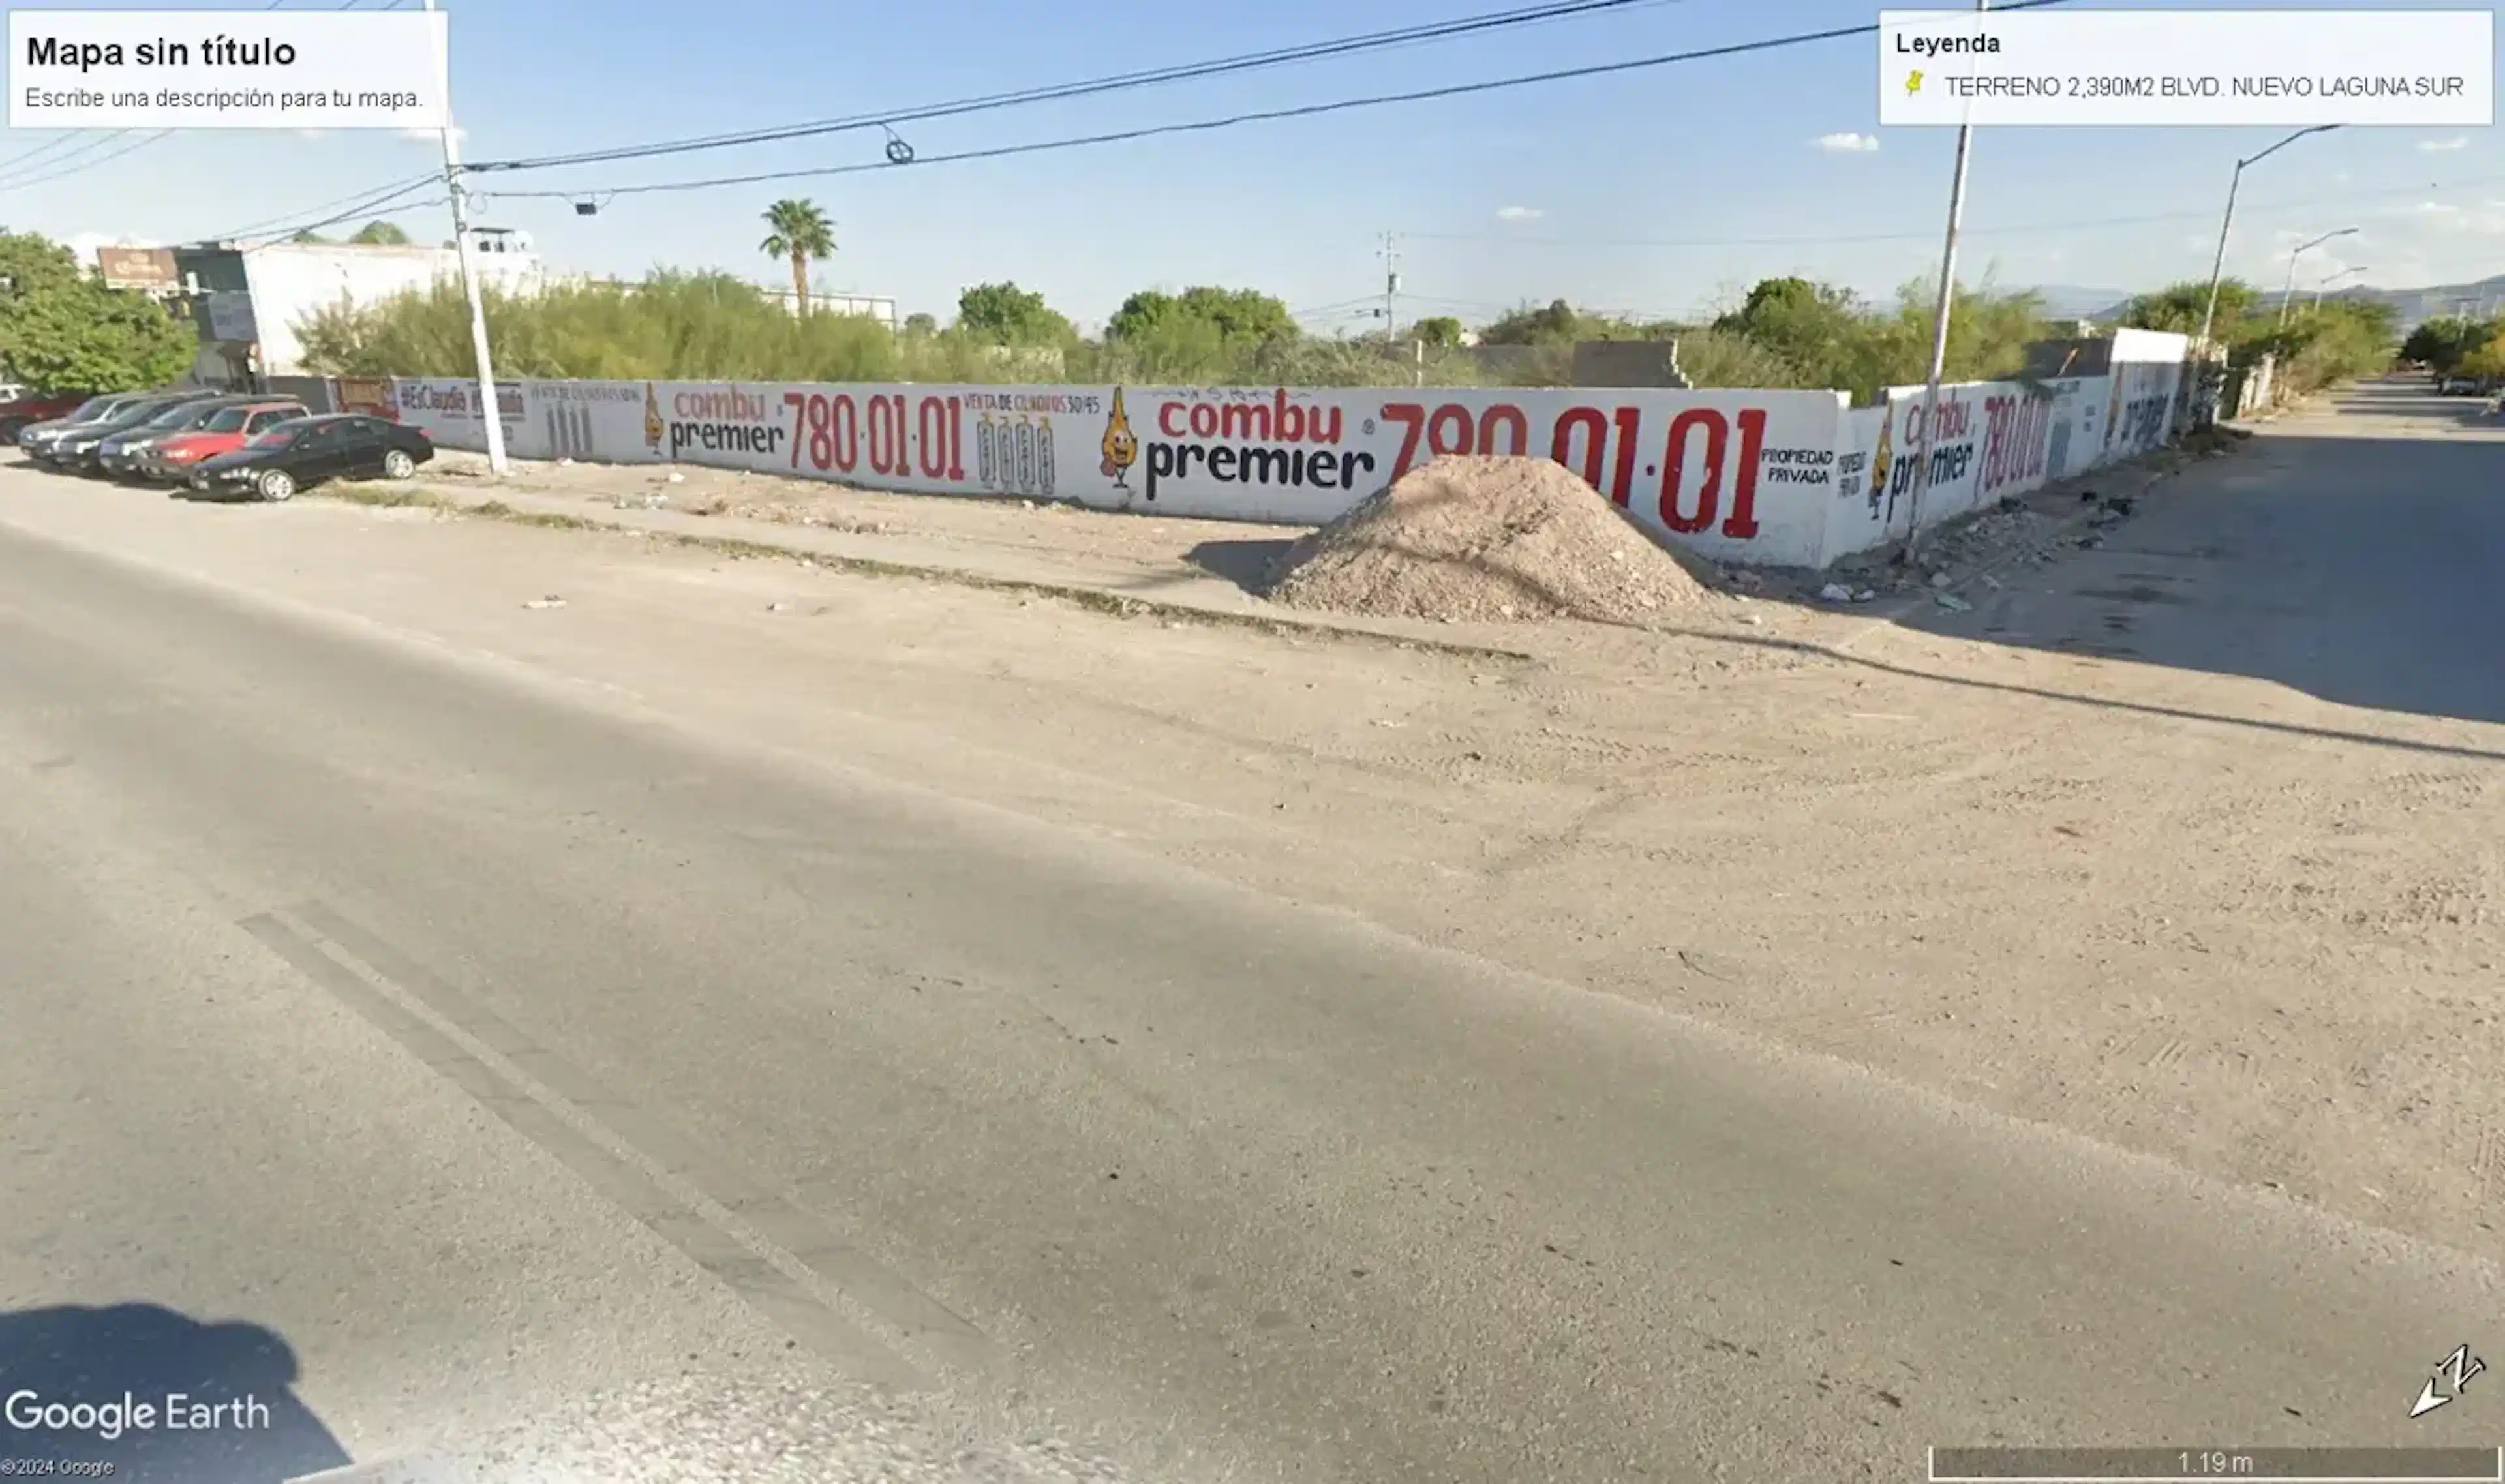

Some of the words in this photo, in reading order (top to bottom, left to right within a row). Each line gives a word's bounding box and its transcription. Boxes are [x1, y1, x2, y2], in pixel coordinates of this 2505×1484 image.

[675, 384, 765, 421] combu
[1159, 388, 1341, 444] combu
[671, 421, 784, 459] premier
[1146, 442, 1375, 501] premier
[1768, 467, 1829, 485] PRIVADA
[1887, 442, 1973, 523] prmier
